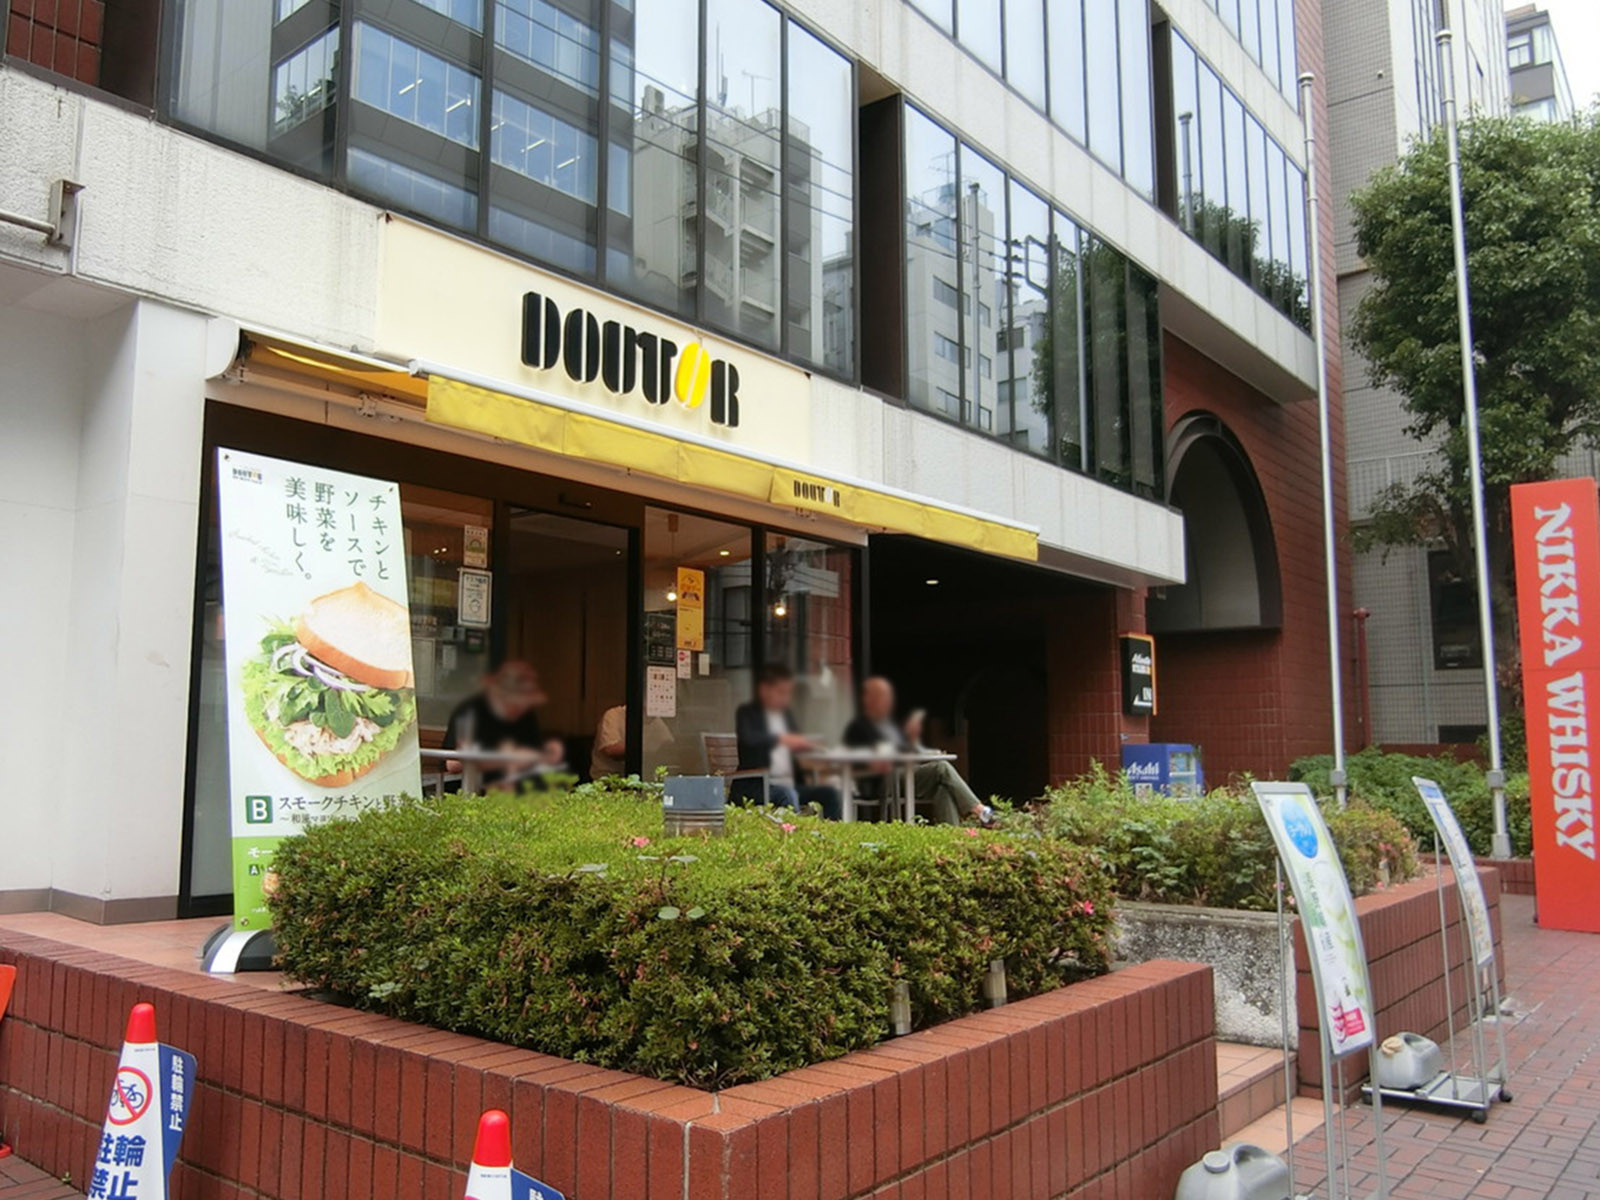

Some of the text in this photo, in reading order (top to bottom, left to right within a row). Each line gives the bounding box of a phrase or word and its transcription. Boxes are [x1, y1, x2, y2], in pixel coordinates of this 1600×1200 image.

[521, 291, 739, 427] DOUTOR
[285, 476, 313, 580] 美味しく。
[315, 481, 337, 552] 野菜を
[345, 491, 367, 577] ソースで
[793, 480, 840, 508] DOUTOR
[368, 494, 390, 580] チキンと
[1534, 502, 1596, 860] NIKKA WHISKY
[1127, 761, 1160, 775] Asahi
[252, 799, 268, 821] B
[169, 1055, 184, 1131] 駐輪禁止
